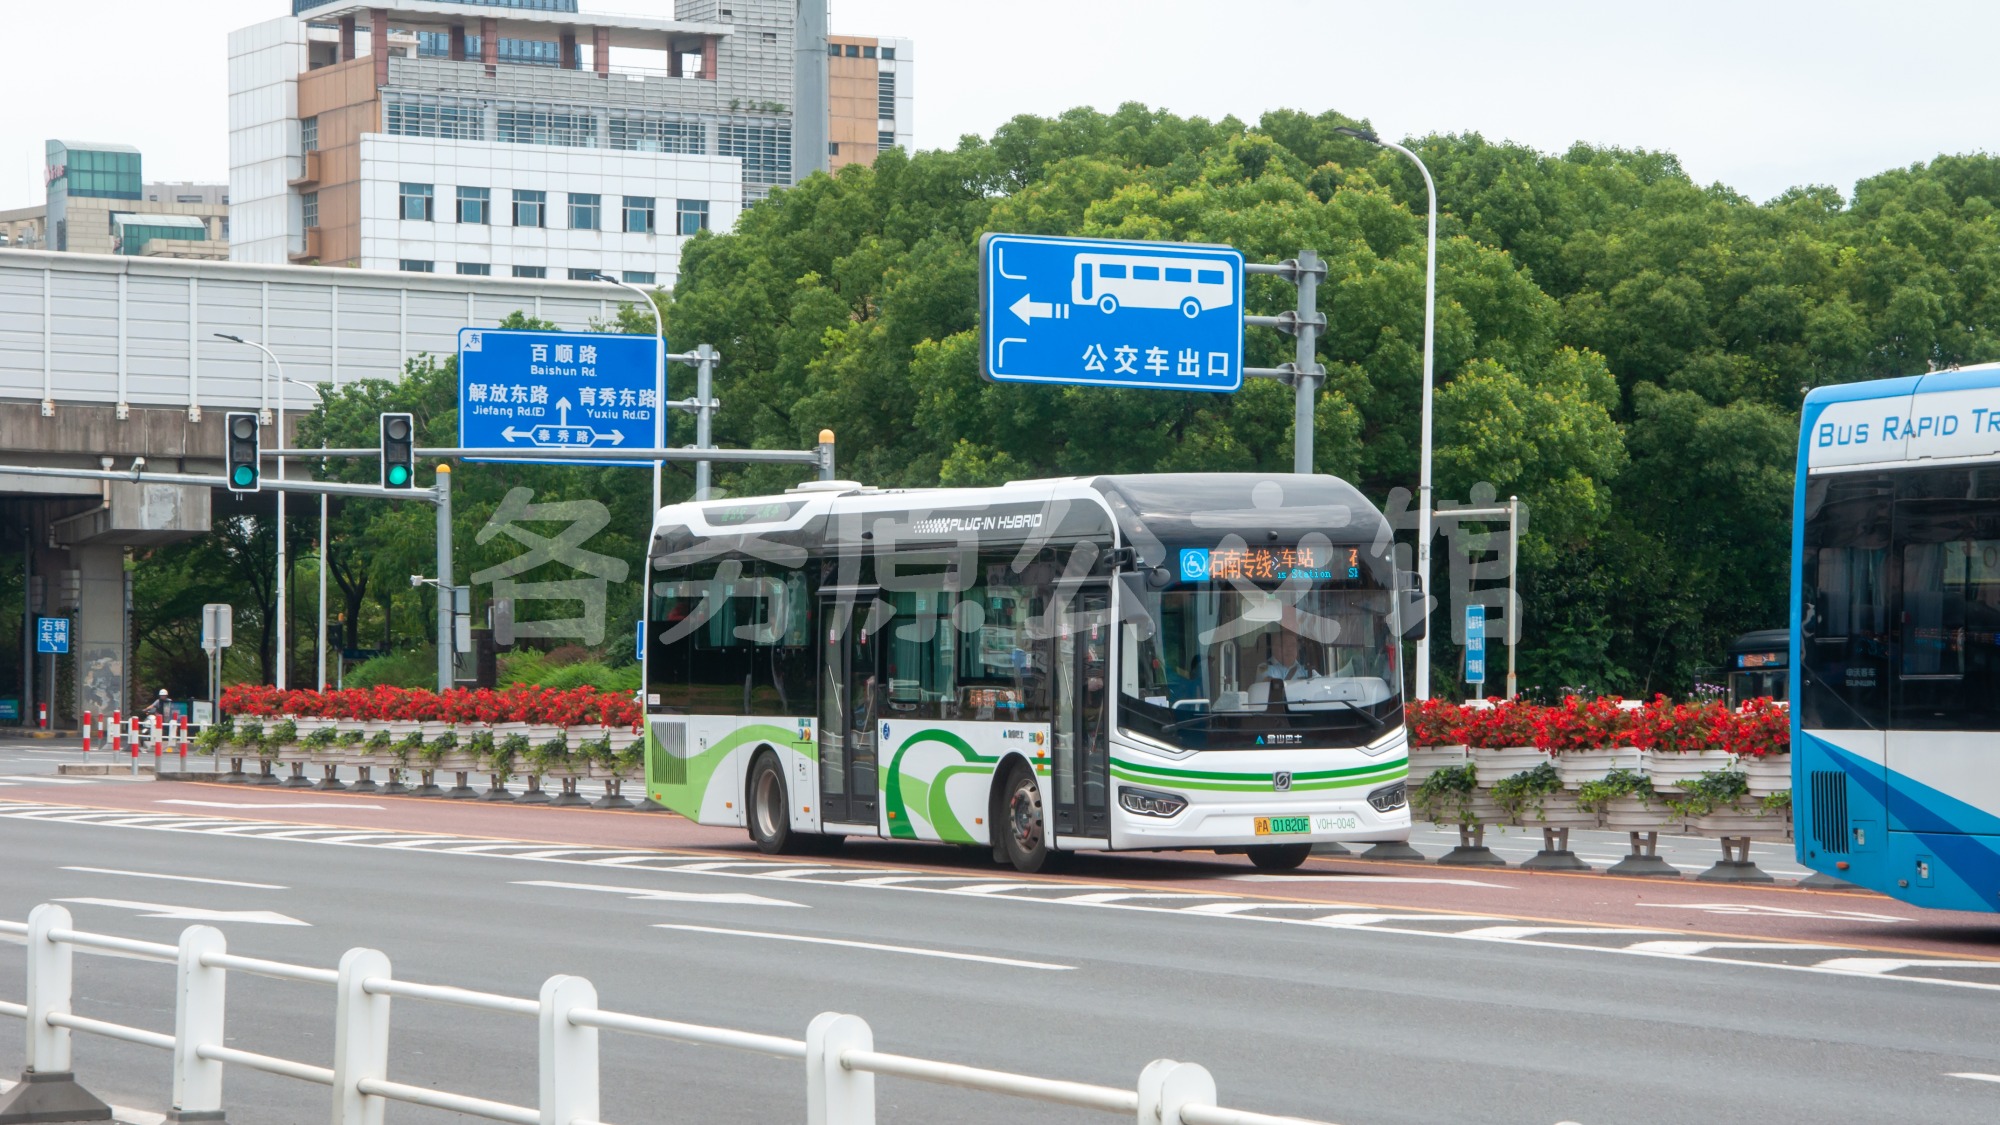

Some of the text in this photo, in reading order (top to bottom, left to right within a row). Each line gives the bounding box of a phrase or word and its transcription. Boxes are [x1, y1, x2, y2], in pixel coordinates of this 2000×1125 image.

[470, 333, 480, 344] 东
[530, 344, 598, 364] 百顺路
[1082, 343, 1229, 377] 公交车出口
[530, 366, 597, 377] Baishun Rd.
[468, 382, 549, 405] 解放东路
[578, 387, 656, 408] 育秀东路
[473, 405, 513, 418] Jiefang
[586, 409, 618, 420] Yuxiu
[538, 429, 589, 443] 奉秀路
[1818, 423, 1869, 447] BUS
[1882, 416, 1959, 441] RAPID
[997, 513, 1043, 529] HYBRID
[1209, 548, 1273, 579] 石南专线
[1277, 547, 1314, 568] 车站
[1291, 567, 1332, 579] Station
[42, 620, 66, 631] 右转
[41, 632, 66, 643] 车辆
